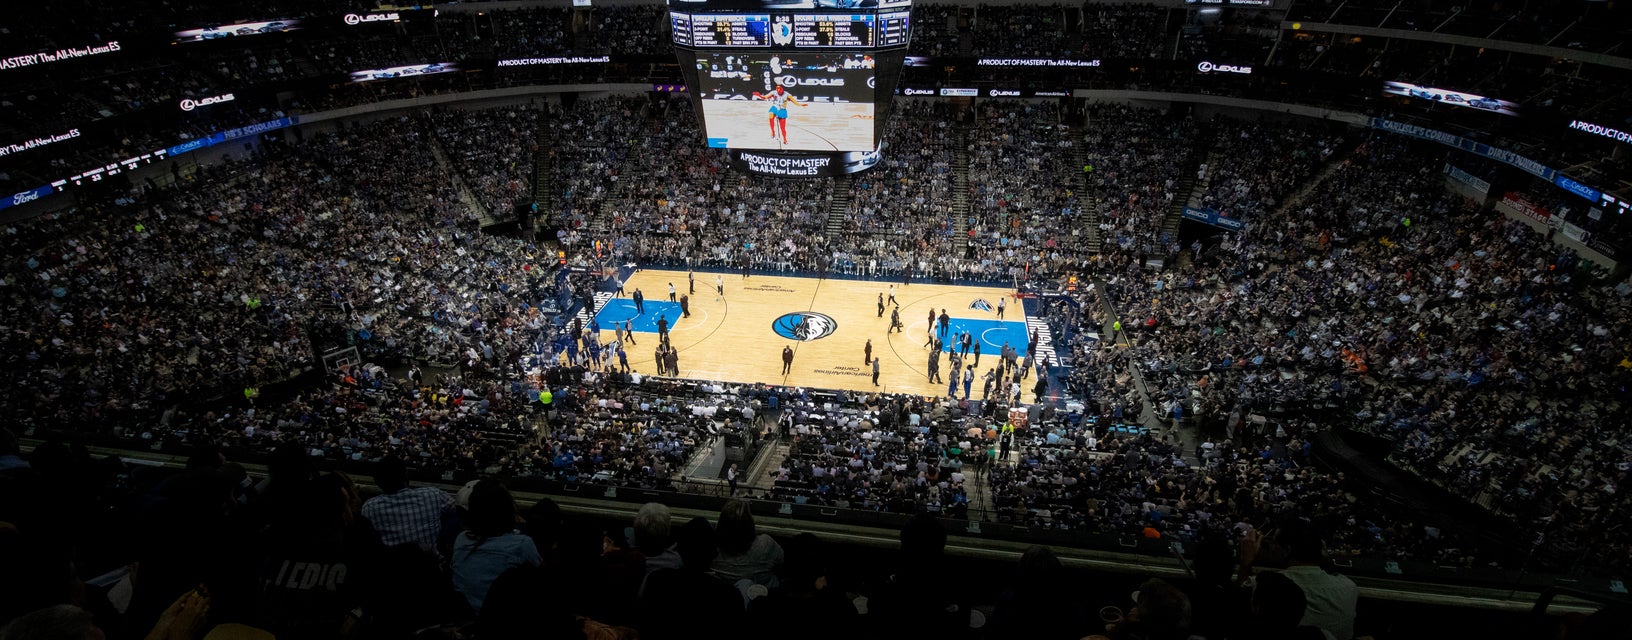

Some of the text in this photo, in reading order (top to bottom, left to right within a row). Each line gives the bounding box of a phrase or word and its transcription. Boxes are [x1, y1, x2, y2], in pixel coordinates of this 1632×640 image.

[359, 13, 399, 22] LEXUS
[38, 52, 56, 63] The
[56, 48, 88, 61] All-New
[86, 45, 109, 56] Lexus
[108, 41, 120, 52] ES
[503, 59, 529, 67] PRODUCT
[1020, 60, 1046, 68] MASTERY
[1212, 64, 1252, 74] LEXUS
[797, 78, 845, 86] LEXUS
[912, 88, 934, 96] LEXUS
[998, 89, 1021, 97] LEXUS
[194, 93, 236, 107] LEXUS
[1569, 120, 1629, 142] A PRODUCT OF
[10, 143, 25, 154] The
[25, 138, 51, 151] All-New
[50, 133, 71, 144] Lexus
[70, 128, 80, 139] ES
[745, 153, 779, 166] PRODUCT
[779, 157, 791, 167] OF
[792, 157, 831, 169] MASTERY
[749, 162, 818, 175] The All-New Lexus ES
[13, 191, 39, 206] Ford
[1186, 209, 1208, 219] GEICO
[1217, 217, 1241, 228] GEICO
